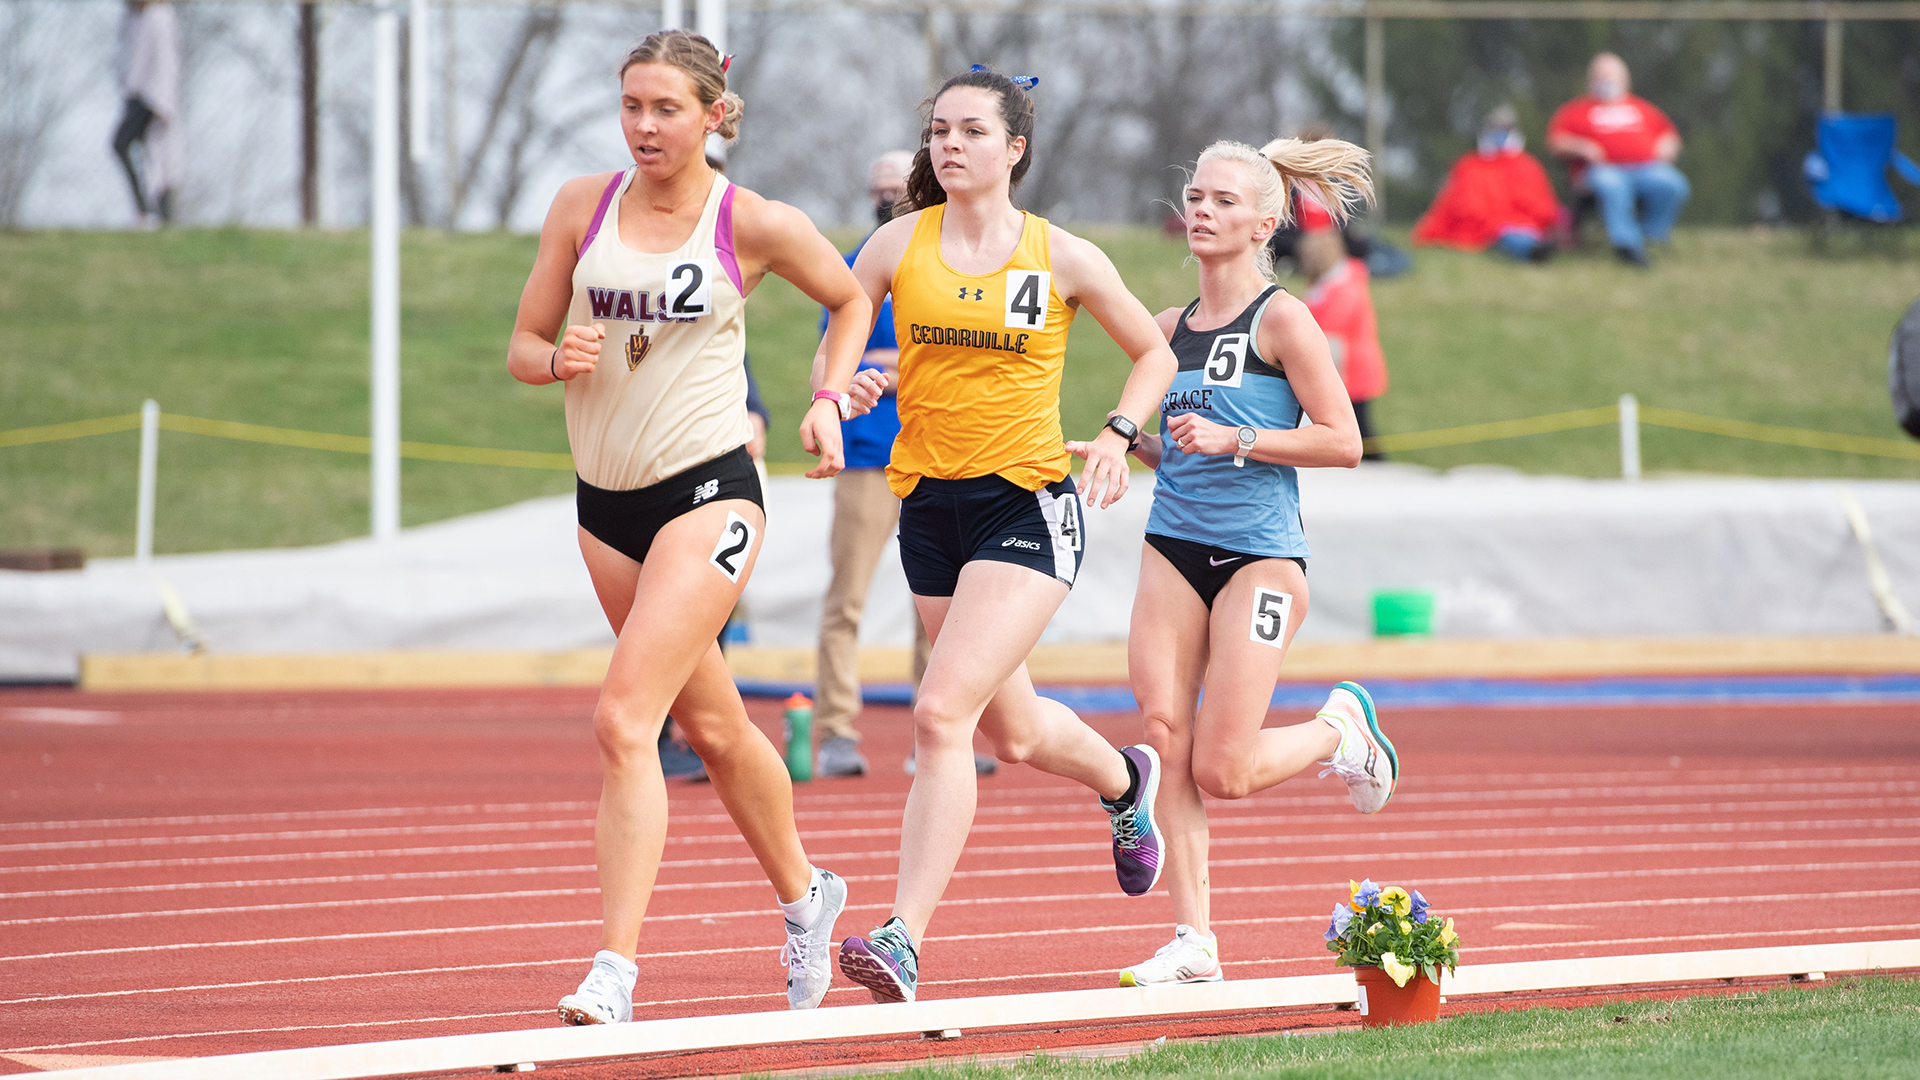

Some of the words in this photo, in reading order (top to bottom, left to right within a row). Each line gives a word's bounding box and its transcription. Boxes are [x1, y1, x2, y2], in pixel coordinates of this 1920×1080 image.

[586, 286, 699, 323] WALS
[671, 262, 704, 314] 2
[1010, 274, 1042, 326] 4
[910, 323, 1029, 354] CEDARVILLE
[1208, 337, 1240, 382] 5
[1060, 497, 1077, 547] 4
[715, 520, 749, 576] 2
[1255, 592, 1284, 642] 5
